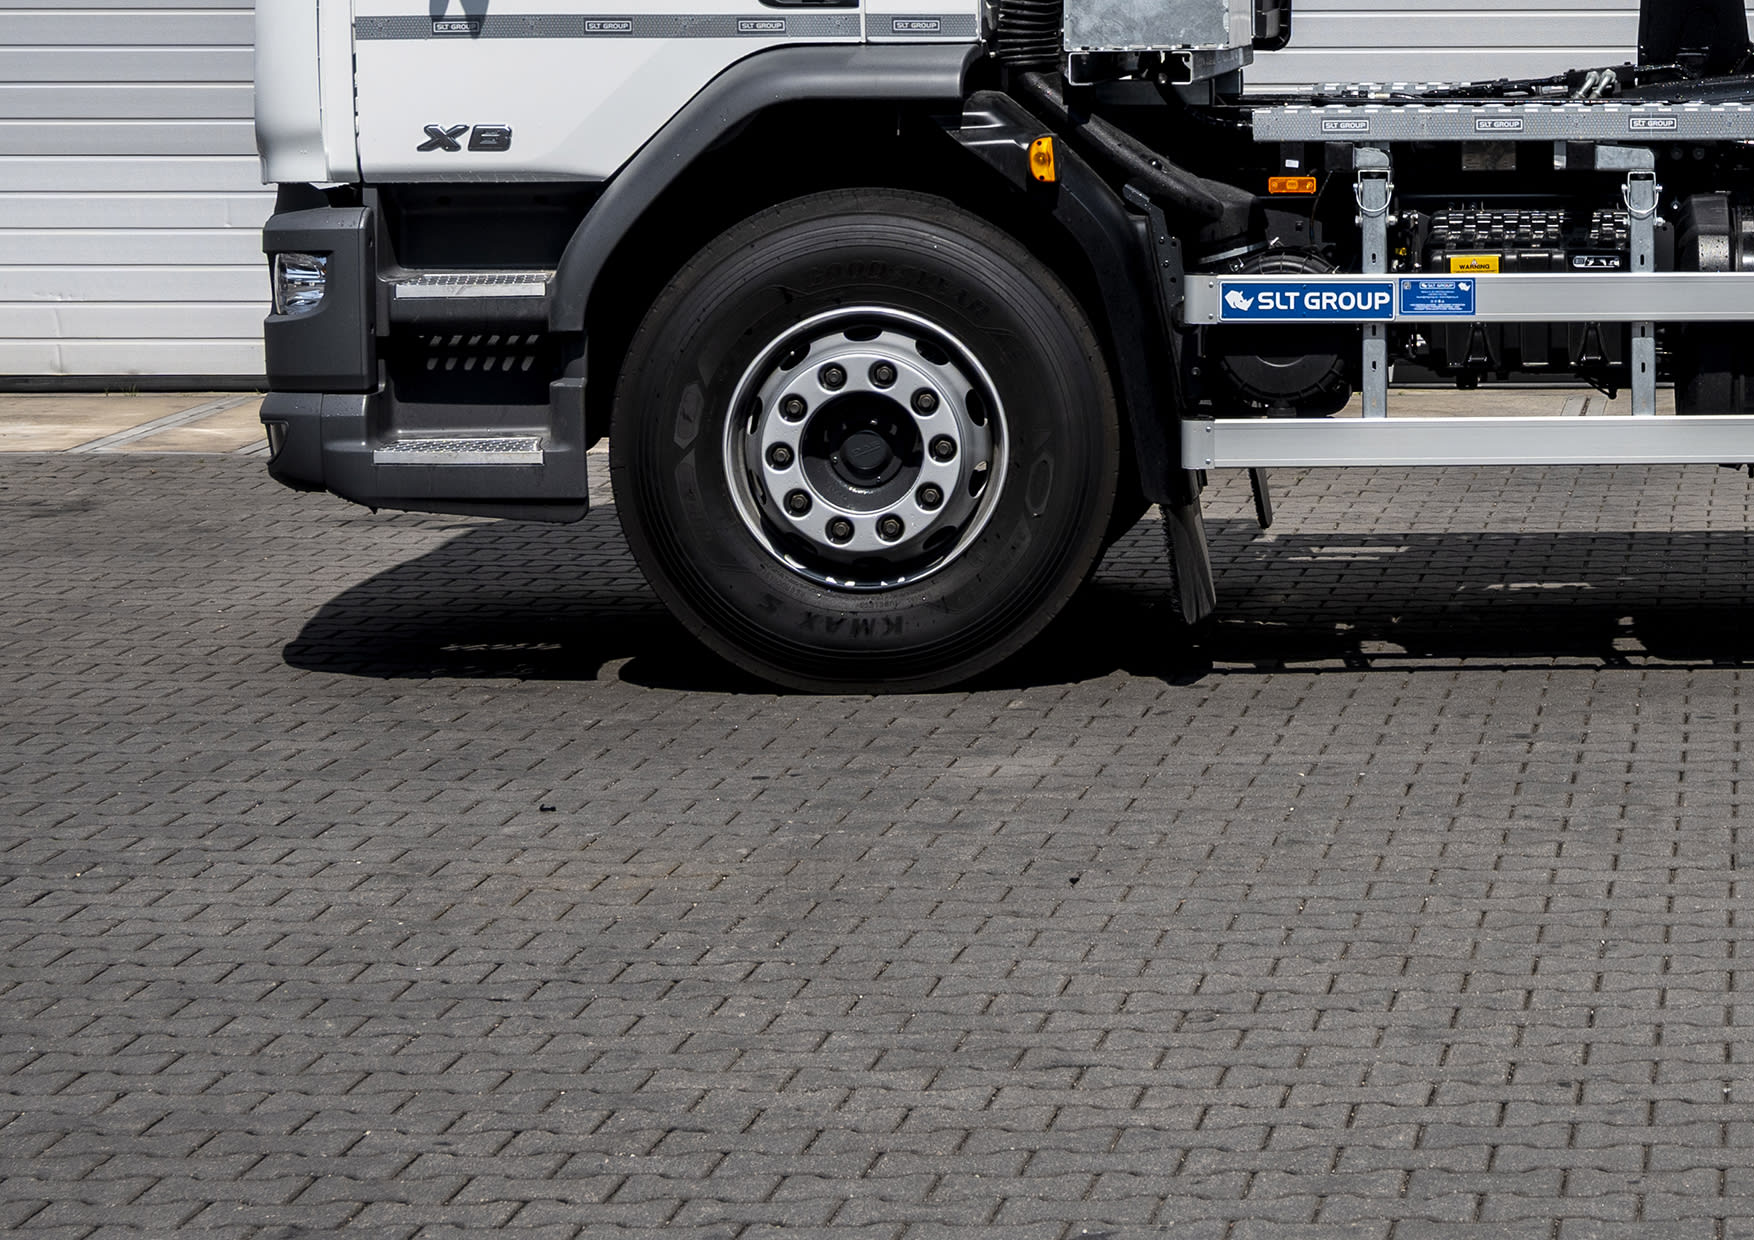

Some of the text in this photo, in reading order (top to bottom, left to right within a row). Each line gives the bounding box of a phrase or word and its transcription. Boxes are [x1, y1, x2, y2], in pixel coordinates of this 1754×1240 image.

[416, 124, 512, 152] XB
[1257, 291, 1300, 310] SLT
[1303, 291, 1391, 310] GROUP
[799, 612, 903, 637] KMAX
